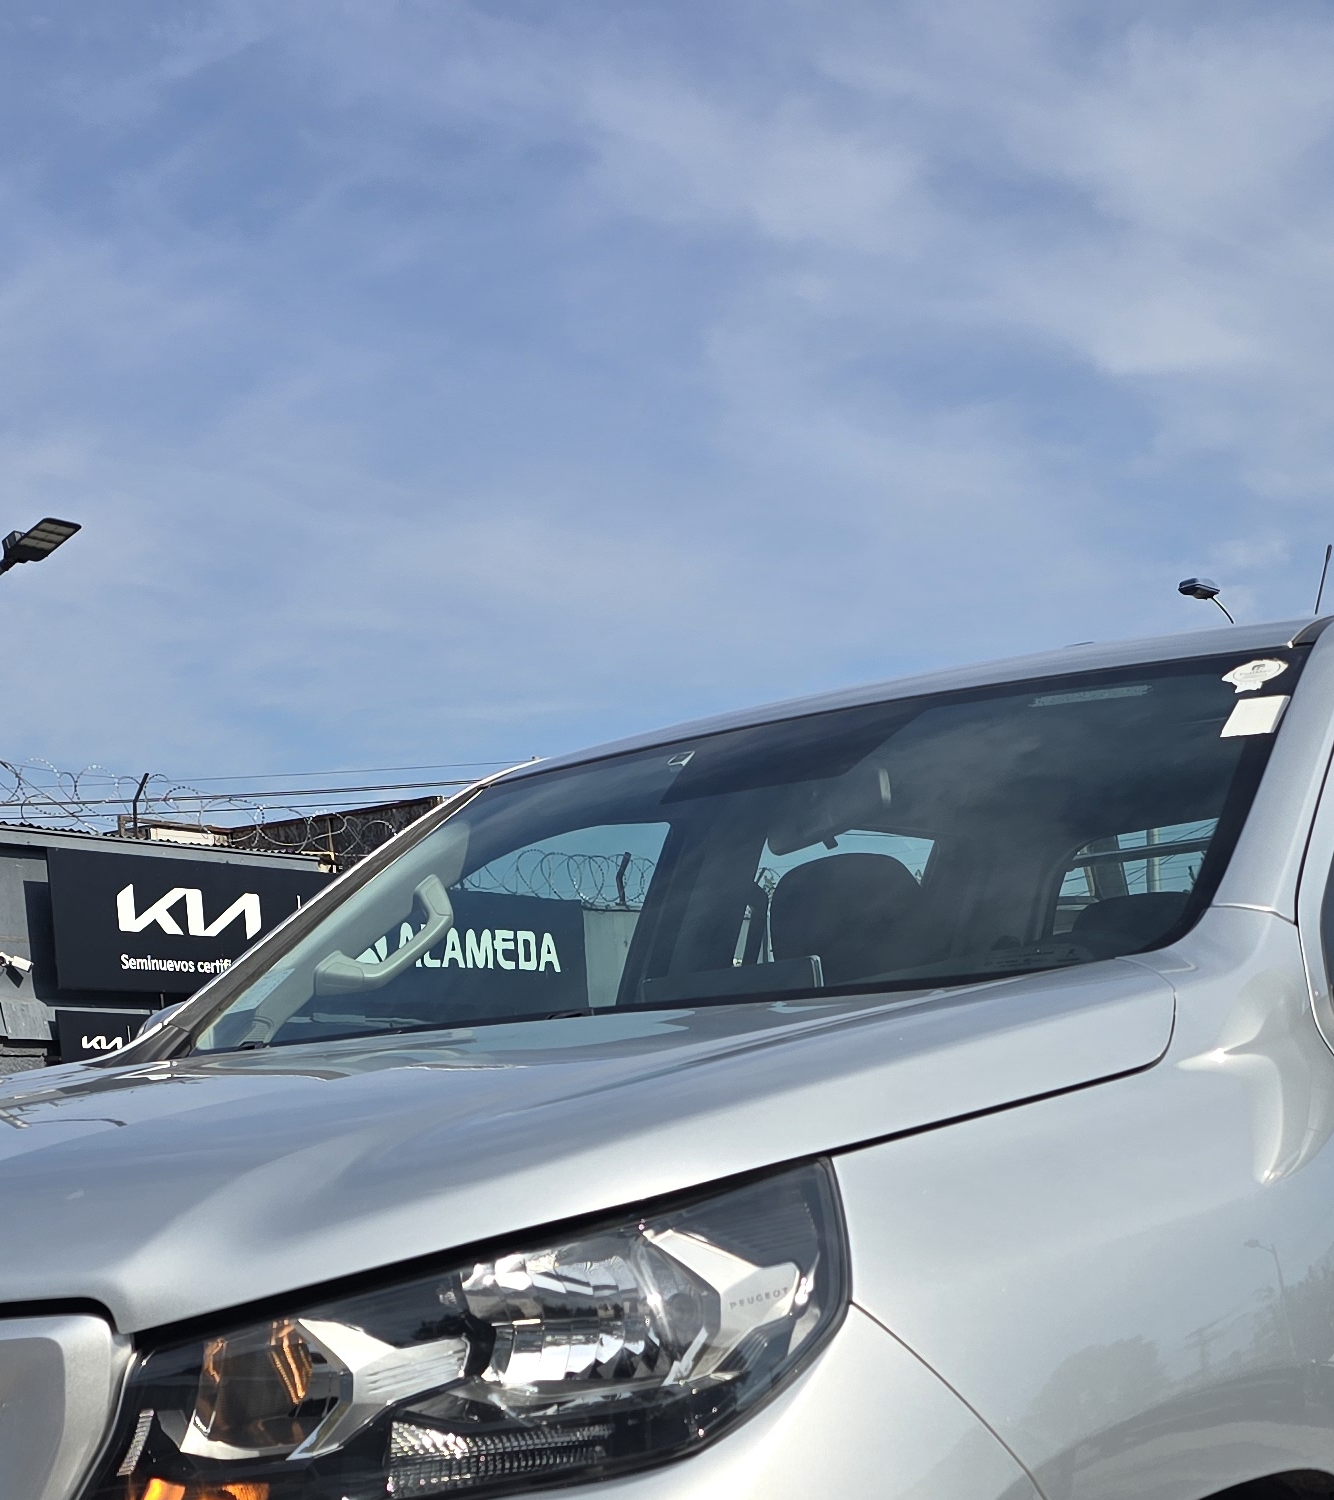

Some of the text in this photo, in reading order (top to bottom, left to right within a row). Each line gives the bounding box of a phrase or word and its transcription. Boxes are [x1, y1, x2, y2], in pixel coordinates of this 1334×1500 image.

[116, 883, 262, 940] KIA
[120, 953, 196, 973] Seminuevos
[729, 1286, 788, 1310] PEUGEOT
